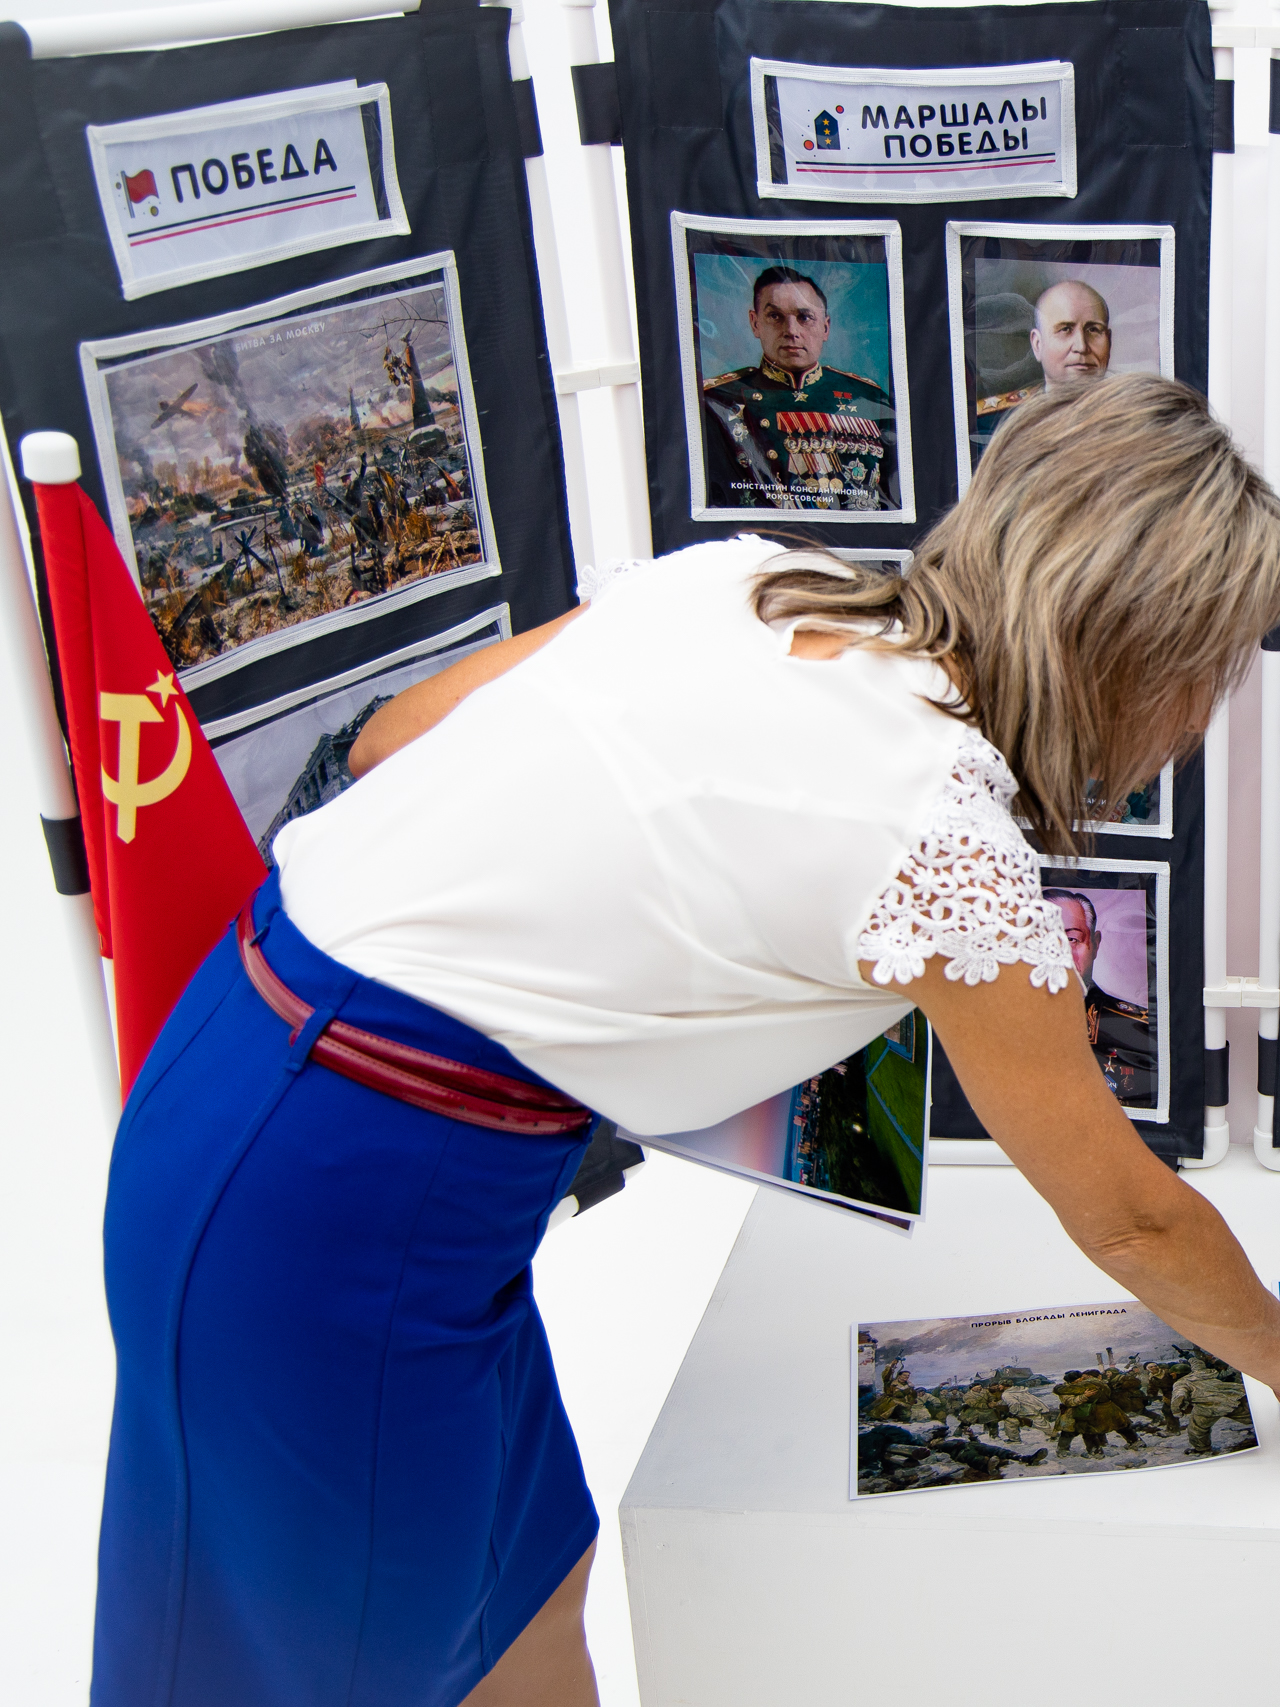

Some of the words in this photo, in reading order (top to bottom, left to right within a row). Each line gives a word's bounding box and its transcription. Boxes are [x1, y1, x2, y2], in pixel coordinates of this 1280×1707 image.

[860, 96, 1048, 130] МАРШАЛЫ
[883, 127, 1029, 159] ПОБЕДЫ
[170, 137, 338, 203] ПОБЕДА
[235, 337, 266, 352] БИТВА
[269, 333, 283, 344] ЗА
[286, 321, 325, 340] МОСКВУ
[730, 482, 788, 492] КОНСТАНТИН
[790, 485, 869, 496] КОНСТАНТИНОВИЧ
[765, 492, 835, 503] РОКОССОВСКИЙ
[971, 1319, 1011, 1328] ПРОРЫВ
[1015, 1313, 1065, 1324] БЛОКАДЫ
[1069, 1308, 1127, 1318] ЛЕНИГРАДА
